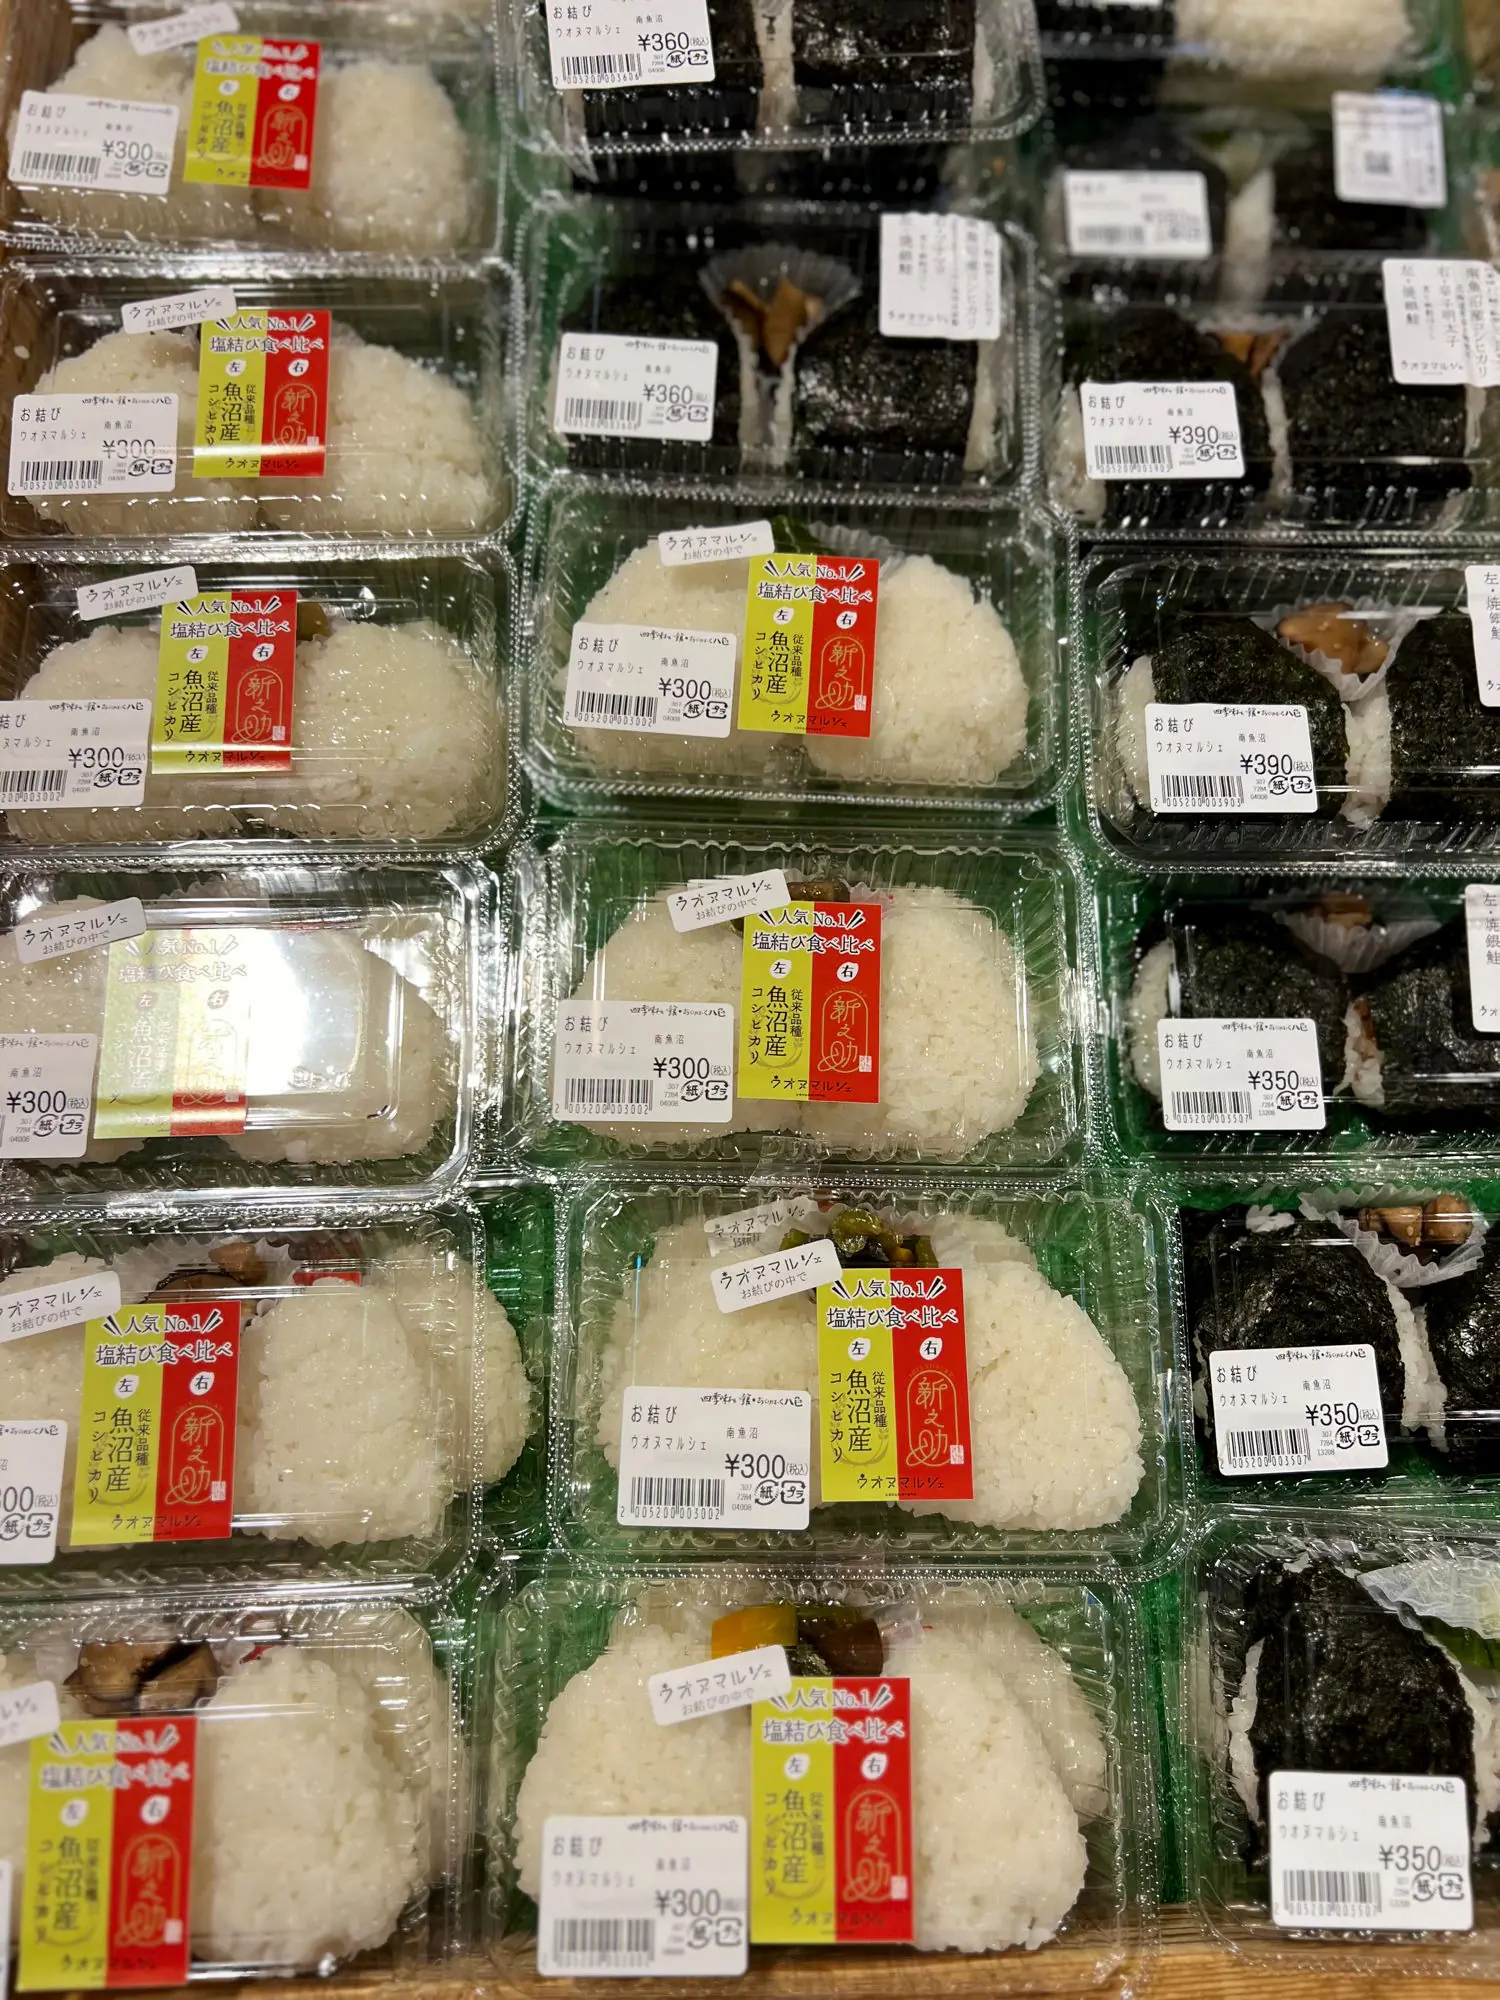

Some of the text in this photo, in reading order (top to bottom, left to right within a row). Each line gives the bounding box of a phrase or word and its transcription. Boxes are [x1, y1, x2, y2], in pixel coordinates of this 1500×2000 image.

[553, 5, 592, 20] お結び
[555, 25, 620, 38] ウオヌマルシェ
[638, 32, 689, 51] ¥360
[102, 141, 153, 161] ¥300
[210, 336, 324, 353] 塩結び食べ比べ
[230, 362, 241, 373] 左
[293, 362, 304, 373] 右
[643, 384, 693, 404] ¥360
[1088, 396, 1125, 409] お結び
[20, 407, 61, 422] お結び
[205, 385, 219, 447] コシヒカリ
[220, 382, 243, 441] 魚沼産
[1090, 416, 1152, 427] ウオヌマルシェ
[20, 430, 86, 442] ウオヌマルシェ
[1169, 426, 1219, 444] ¥390
[102, 439, 155, 459] ¥300
[758, 582, 872, 604] 塩結び食べ比べ
[777, 610, 788, 621] 左
[841, 614, 853, 626] 右
[170, 621, 290, 638] 塩結び食べ比べ
[190, 648, 203, 659] 左
[258, 646, 269, 658] 右
[578, 637, 619, 653] お結び
[766, 631, 790, 695] 魚沼産
[791, 634, 804, 677] 従来品種
[577, 659, 643, 674] ウオヌマルシェ
[751, 632, 765, 700] コシヒカリ
[206, 671, 219, 714] 従来品種
[658, 678, 711, 700] ¥300
[164, 673, 179, 741] コシヒカリ
[179, 670, 204, 733] 魚沼産
[1154, 717, 1194, 733] お結び
[1156, 741, 1223, 753] ウオヌマルシェ
[68, 747, 124, 768] ¥300
[1240, 754, 1292, 775] ¥390
[676, 880, 772, 911] ウオヌマルシェ
[24, 913, 128, 945] ウオヌマルシェ
[753, 932, 875, 954] 塩結び食べ比べ
[773, 963, 786, 975] 左
[841, 965, 854, 978] 右
[765, 986, 788, 1057] 魚沼産
[790, 989, 803, 1037] 従来品種
[749, 987, 763, 1065] コシヒカリ
[1164, 1033, 1202, 1049] お結び
[653, 1057, 709, 1079] ¥300
[1166, 1059, 1231, 1070] ウオヌマルシェ
[1248, 1071, 1299, 1090] ¥350
[6, 1091, 66, 1113] ¥300
[720, 1252, 822, 1289] ウオヌマルシェ
[827, 1307, 958, 1329] 塩結び食べ比べ
[96, 1343, 233, 1365] 塩結び食べ比べ
[851, 1341, 865, 1356] 左
[924, 1340, 939, 1355] 右
[195, 1377, 209, 1390] 右
[1216, 1365, 1257, 1383] お結び
[119, 1379, 133, 1393] 左
[872, 1371, 887, 1428] 従来品種
[1220, 1392, 1288, 1407] ウオヌマルシェ
[631, 1404, 677, 1425] お結び
[830, 1372, 843, 1464] コシヒカリ
[846, 1369, 872, 1452] 魚沼産
[1306, 1403, 1359, 1426] ¥350
[135, 1408, 151, 1466] 従来品種
[631, 1436, 707, 1450] ウオヌマルシェ
[89, 1412, 106, 1504] コシヒカリ
[105, 1408, 134, 1493] 魚沼産
[725, 1454, 785, 1478] ¥300
[763, 1719, 904, 1743] 塩結び食べ比べ
[788, 1759, 803, 1773] 左
[868, 1758, 881, 1773] 右
[1277, 1791, 1324, 1811] お結び
[781, 1789, 808, 1884] 魚沼産
[1279, 1825, 1359, 1842] ウオヌマルシェ
[1379, 1845, 1441, 1871] ¥350
[655, 1888, 720, 1917] ¥300
